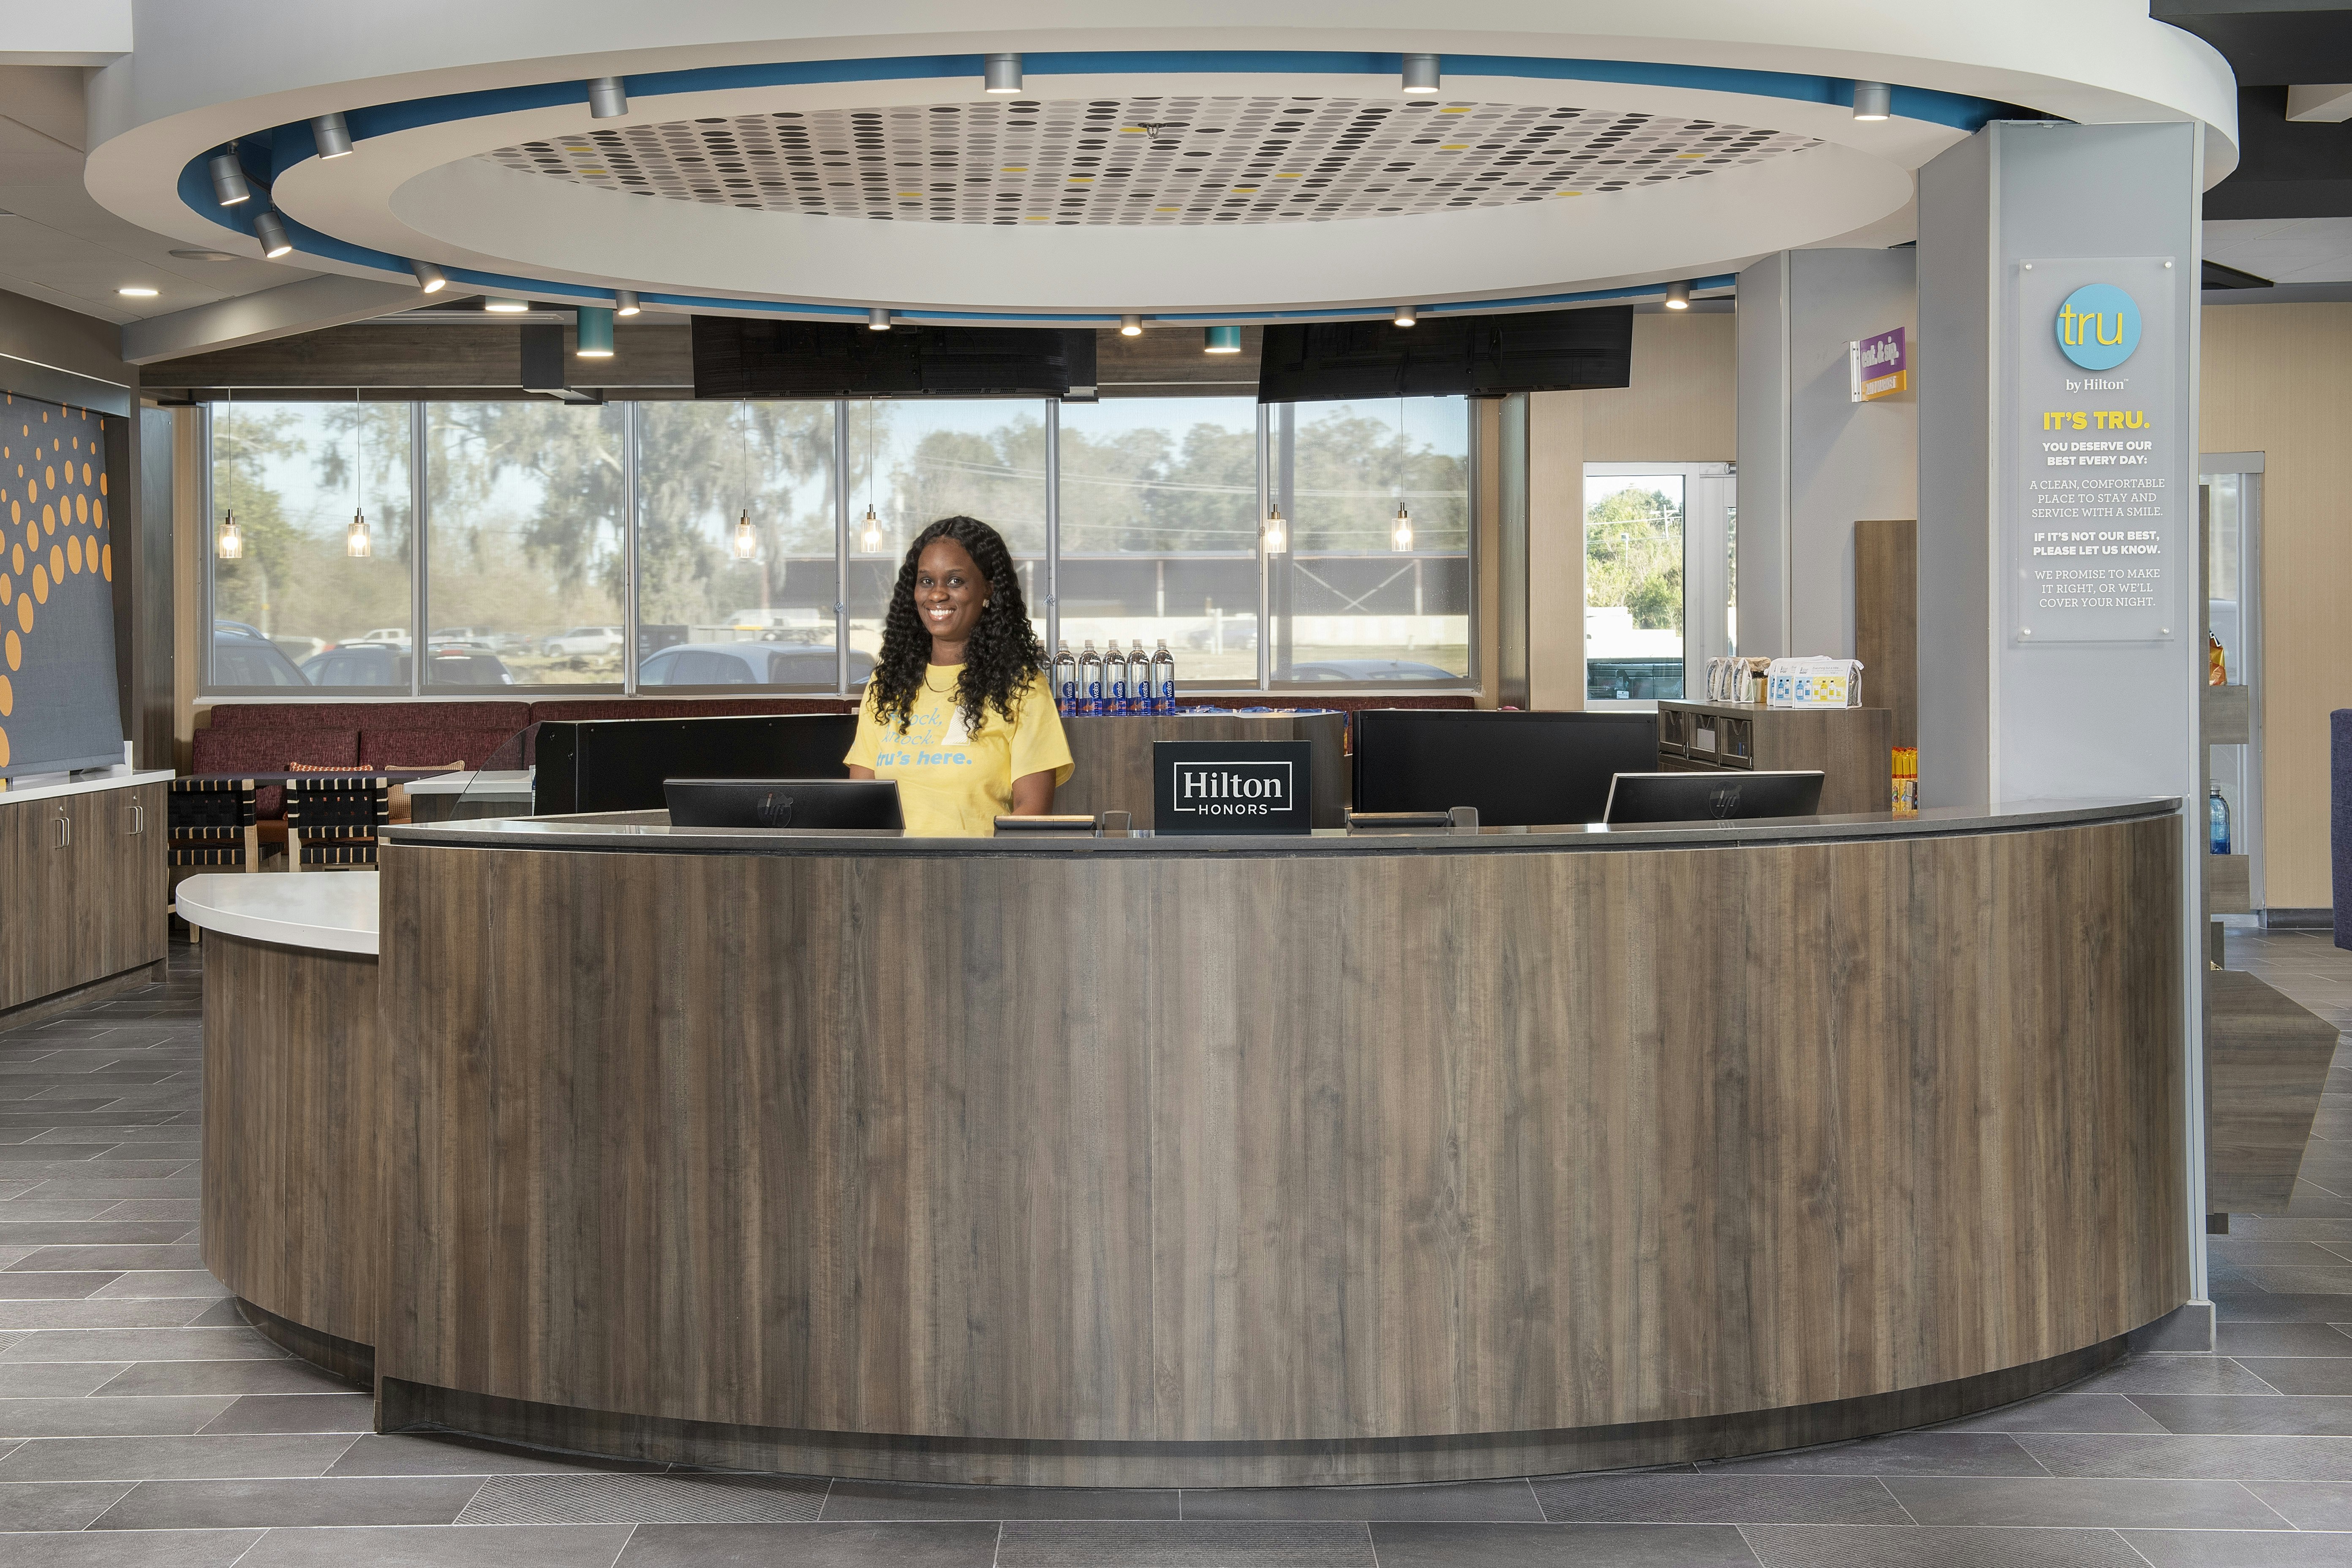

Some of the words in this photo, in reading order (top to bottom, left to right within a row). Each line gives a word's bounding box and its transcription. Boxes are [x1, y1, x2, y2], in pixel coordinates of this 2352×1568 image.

[2059, 304, 2123, 345] tru
[2066, 379, 2082, 393] by
[2044, 411, 2088, 430] IT'S
[2093, 411, 2150, 429] TRU.
[2042, 442, 2068, 452] YOU
[2071, 441, 2123, 451] DESERVE
[2126, 441, 2152, 450] OUR
[2047, 456, 2077, 466] BEST
[2079, 455, 2117, 465] EVERY
[2120, 455, 2148, 464] DAY:
[2029, 481, 2038, 490] A
[2040, 480, 2079, 490] CLEAN,
[2082, 479, 2165, 489] COMFORTABLE
[2038, 494, 2075, 504] PLACE
[2078, 494, 2094, 503] TO
[2098, 493, 2128, 503] STAY
[2130, 493, 2156, 502] AND
[2032, 508, 2079, 518] SERVICE
[2081, 508, 2113, 517] WITH
[2115, 507, 2124, 516] A
[2127, 507, 2163, 516] SMILE.
[2034, 533, 2045, 542] IF
[2047, 532, 2069, 542] IT'S
[2072, 532, 2096, 541] NOT
[2098, 531, 2124, 541] OUR
[2127, 531, 2160, 541] BEST,
[2033, 546, 2076, 555] PLEASE
[2079, 546, 2099, 555] LET
[2102, 545, 2118, 555] US
[2121, 545, 2161, 554] KNOW.
[2034, 570, 2053, 580] WE
[2055, 569, 2105, 579] PROMISE
[2108, 569, 2124, 578] TO
[2127, 569, 2160, 578] MAKE
[2042, 585, 2053, 593] IT
[2056, 584, 2096, 594] RIGHT,
[2099, 583, 2116, 593] OR
[2118, 583, 2153, 592] WE'LL
[2039, 598, 2079, 607] COVER
[2080, 598, 2113, 607] YOUR
[2115, 597, 2156, 606] NIGHT.
[882, 725, 934, 745] knock.
[877, 751, 911, 766] tru's
[917, 751, 972, 765] here.
[1184, 772, 1282, 798] Hilton
[1199, 804, 1267, 815] HONORS
